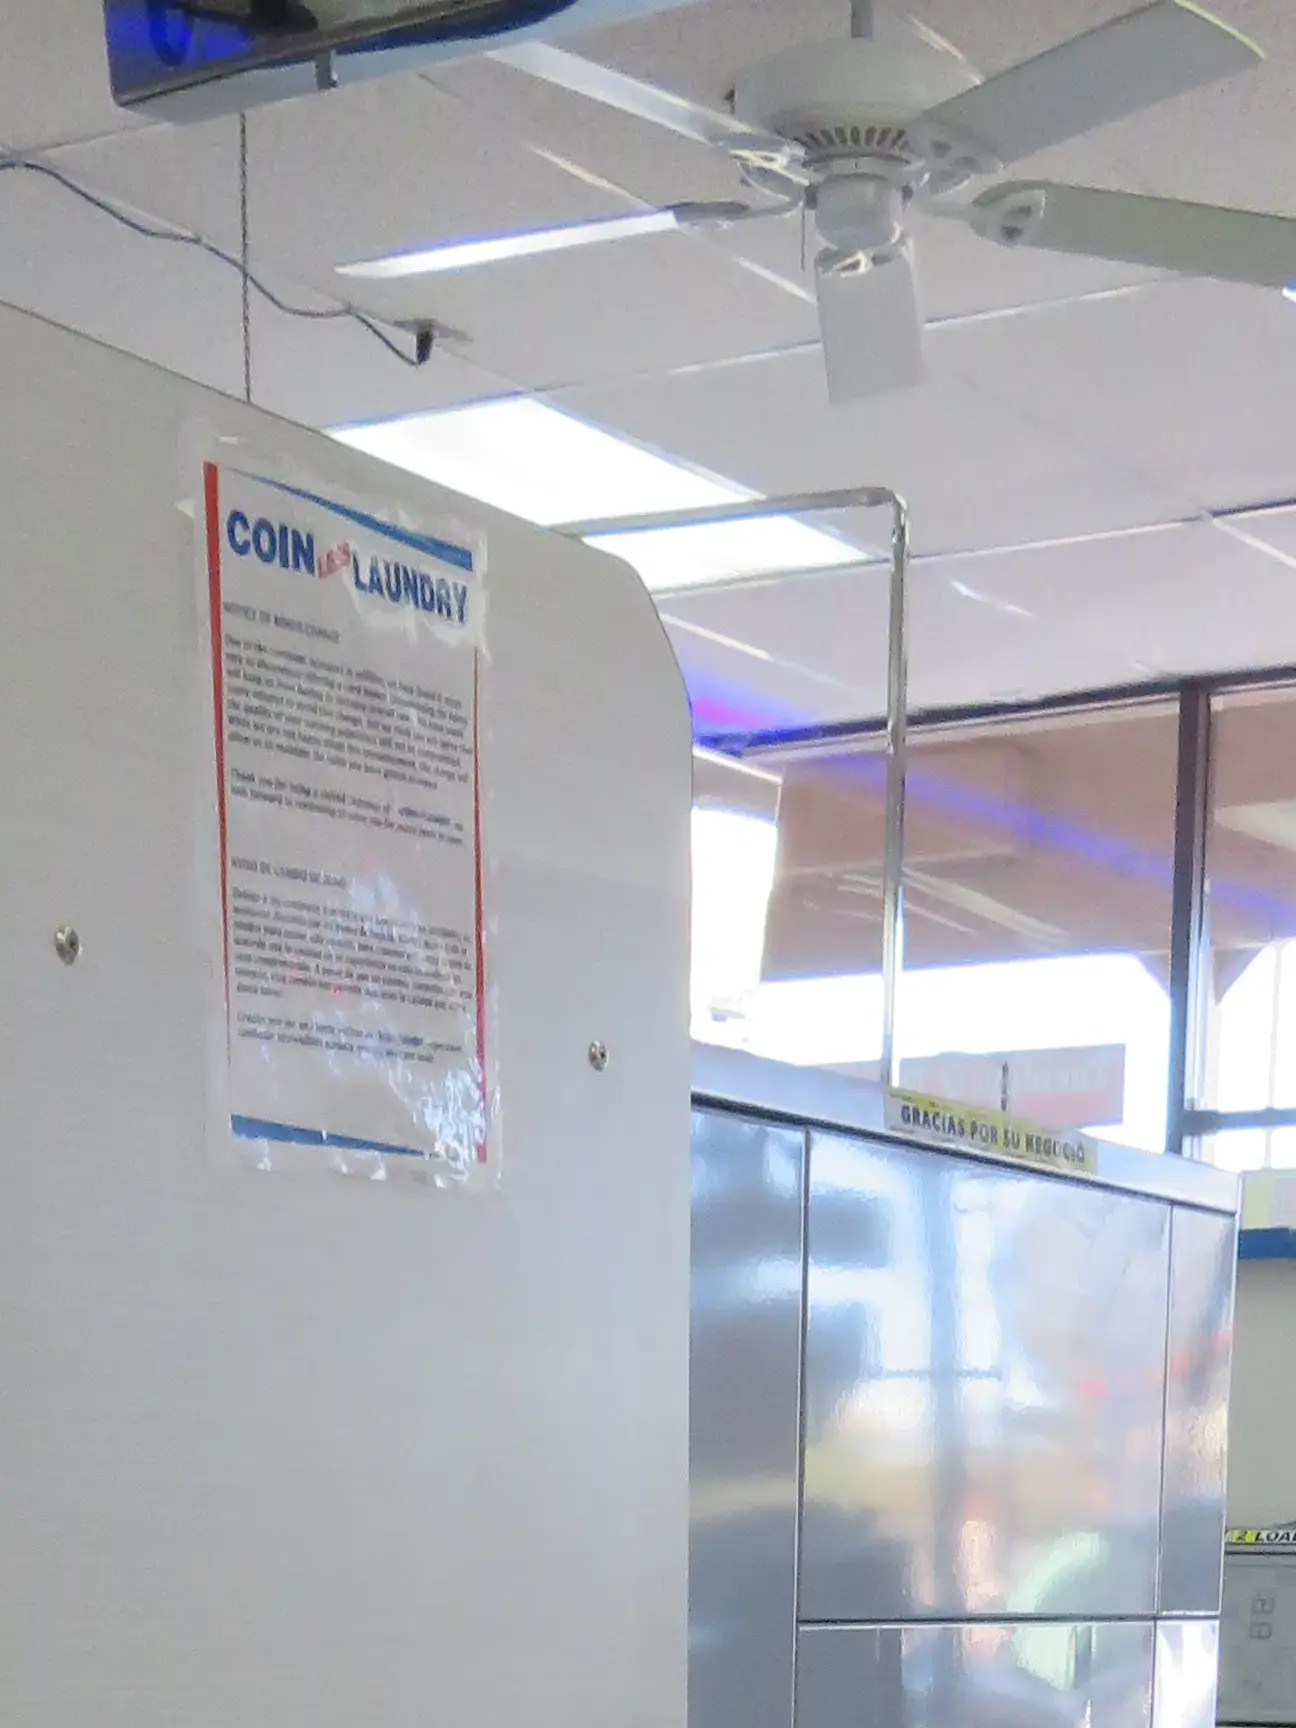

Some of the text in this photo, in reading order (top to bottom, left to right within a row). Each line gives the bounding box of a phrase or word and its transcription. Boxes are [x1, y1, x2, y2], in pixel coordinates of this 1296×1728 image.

[226, 508, 316, 577] COIN
[352, 551, 468, 626] LAUNDRY
[901, 1104, 965, 1138] GRACIAS
[970, 1120, 999, 1145] POR
[1003, 1126, 1021, 1150] SU
